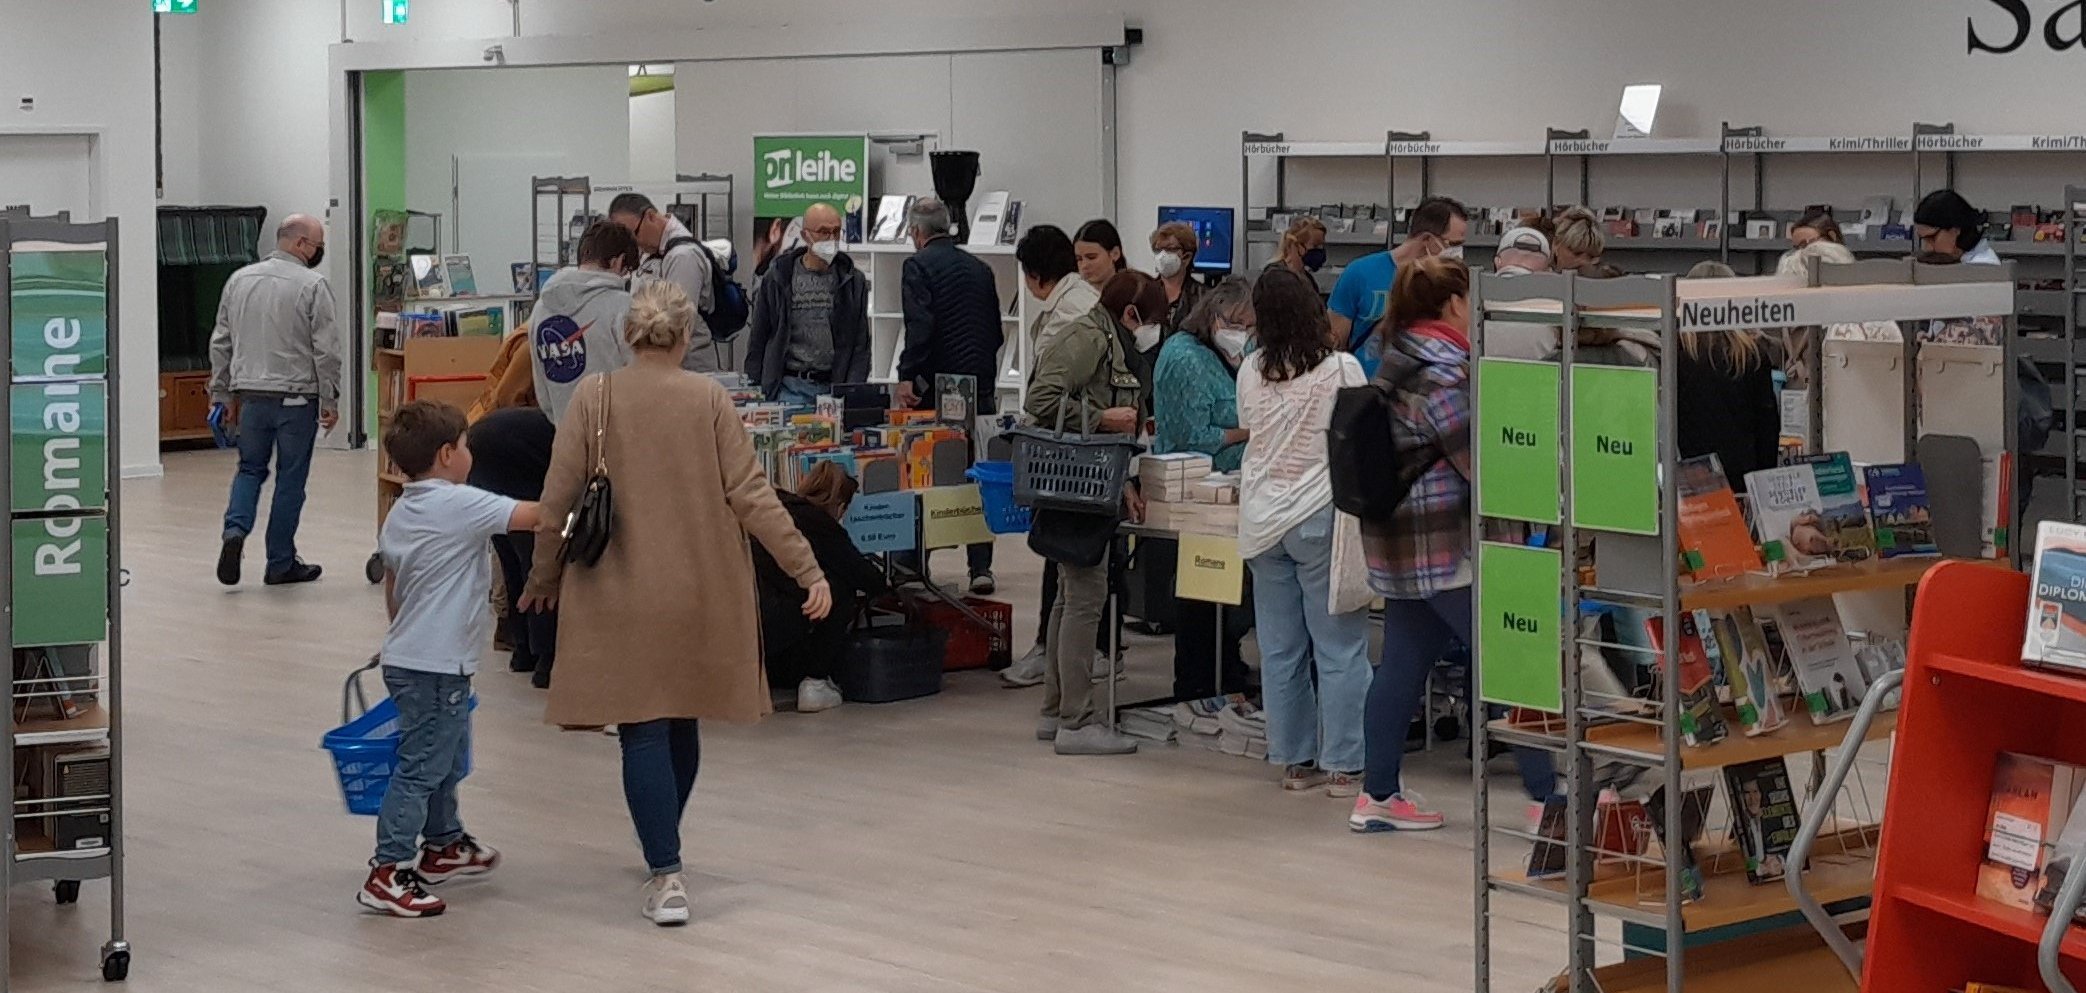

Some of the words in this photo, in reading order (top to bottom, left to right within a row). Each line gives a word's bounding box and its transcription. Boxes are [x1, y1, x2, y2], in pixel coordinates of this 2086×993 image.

[1244, 144, 1290, 153] Hörbücher
[1390, 143, 1440, 153] Hörbücher
[1554, 140, 1609, 152] Hörbücher
[1726, 138, 1786, 150] Hörbücher
[1829, 137, 1910, 150] Krimi/Thriller
[1917, 136, 1983, 148] Hörbücher
[1682, 298, 1796, 327] Neuheiten
[537, 340, 585, 361] NASA
[1502, 427, 1537, 447] Neu
[1597, 435, 1633, 455] Neu
[35, 317, 82, 576] Romane
[2071, 575, 2086, 588] DI
[1503, 611, 1538, 633] Neu
